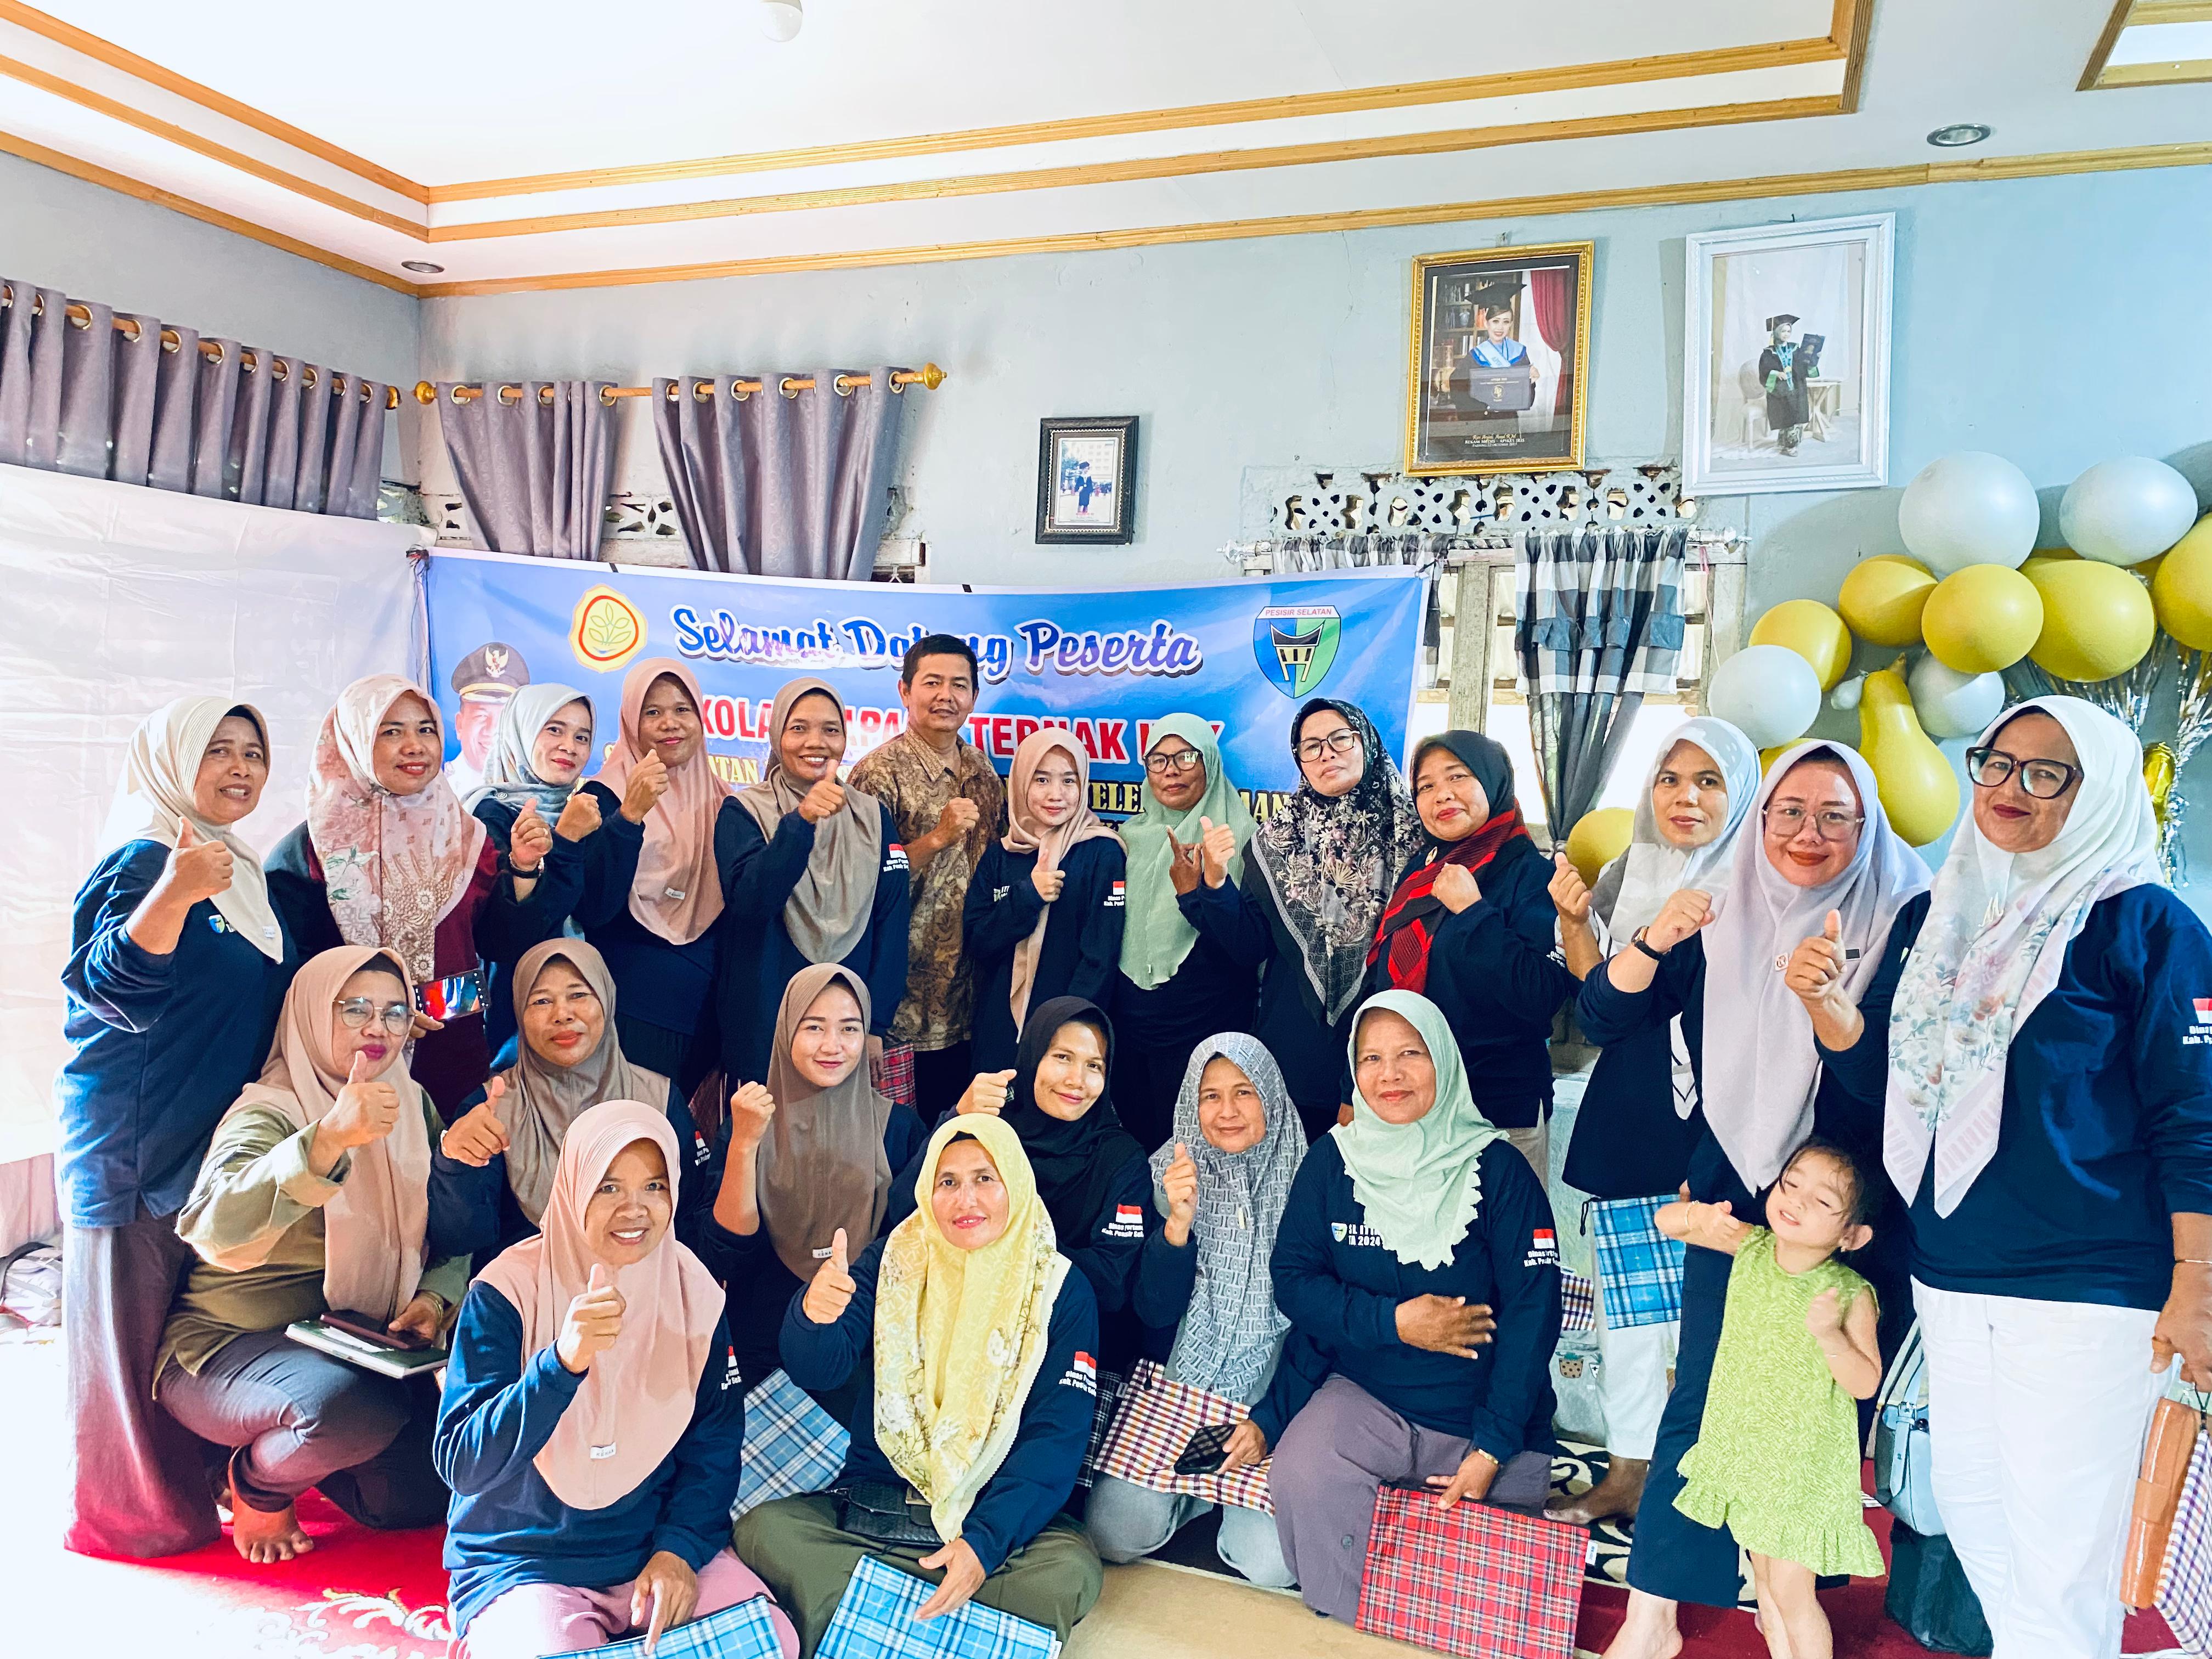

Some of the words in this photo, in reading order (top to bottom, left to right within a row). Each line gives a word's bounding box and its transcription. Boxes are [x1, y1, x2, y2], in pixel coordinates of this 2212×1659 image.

[670, 605, 843, 662] Selamat
[1014, 619, 1203, 678] Peserta
[1348, 1224, 1358, 1234] SL
[1357, 1235, 1381, 1246] 2024
